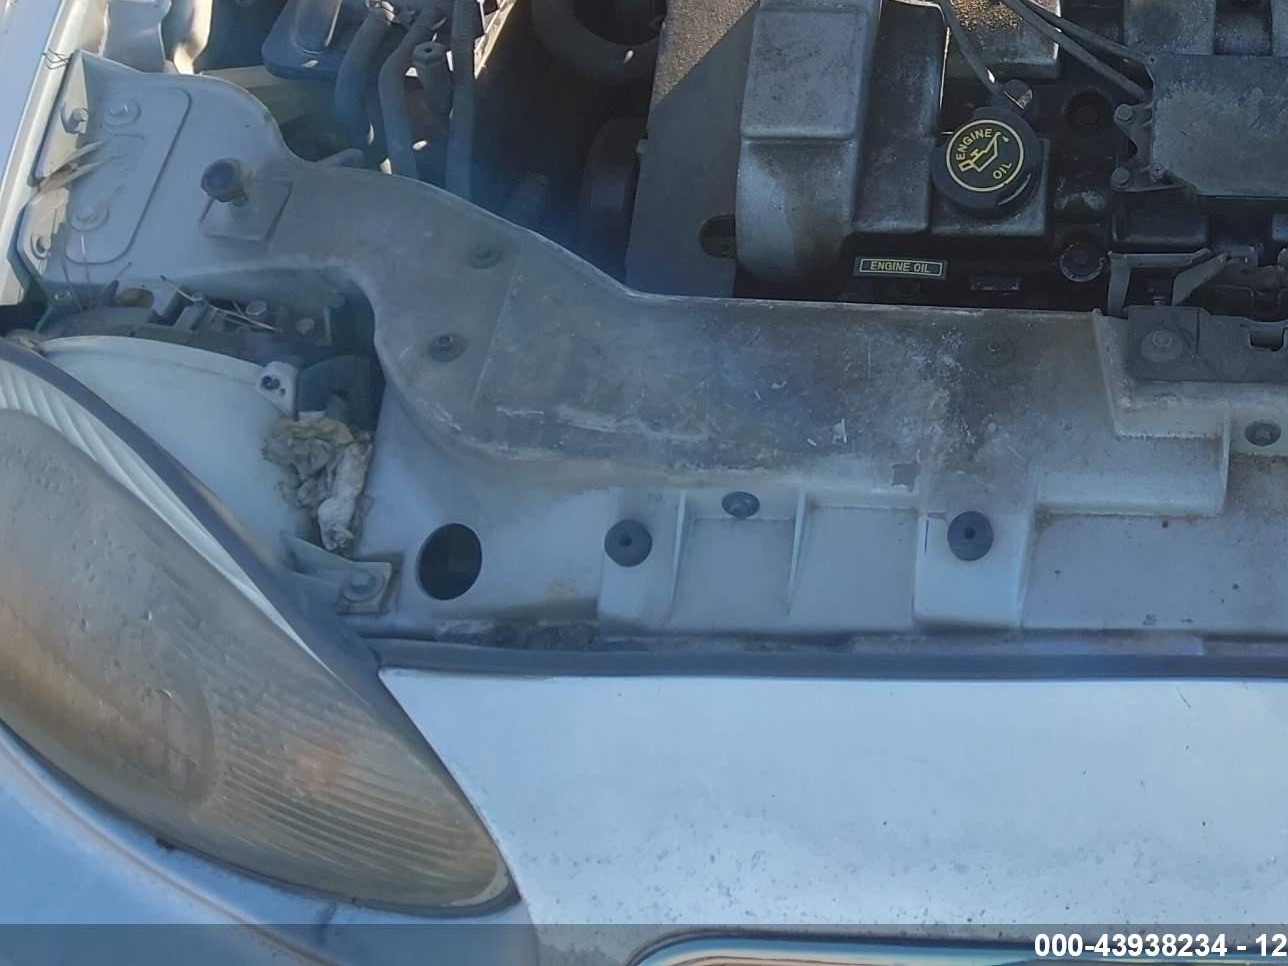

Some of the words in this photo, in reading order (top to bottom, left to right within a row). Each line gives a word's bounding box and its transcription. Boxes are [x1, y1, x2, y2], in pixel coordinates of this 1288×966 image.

[955, 128, 993, 161] ENGINE
[992, 162, 1013, 180] OIL
[870, 260, 911, 272] ENGINE
[913, 263, 929, 273] OIL
